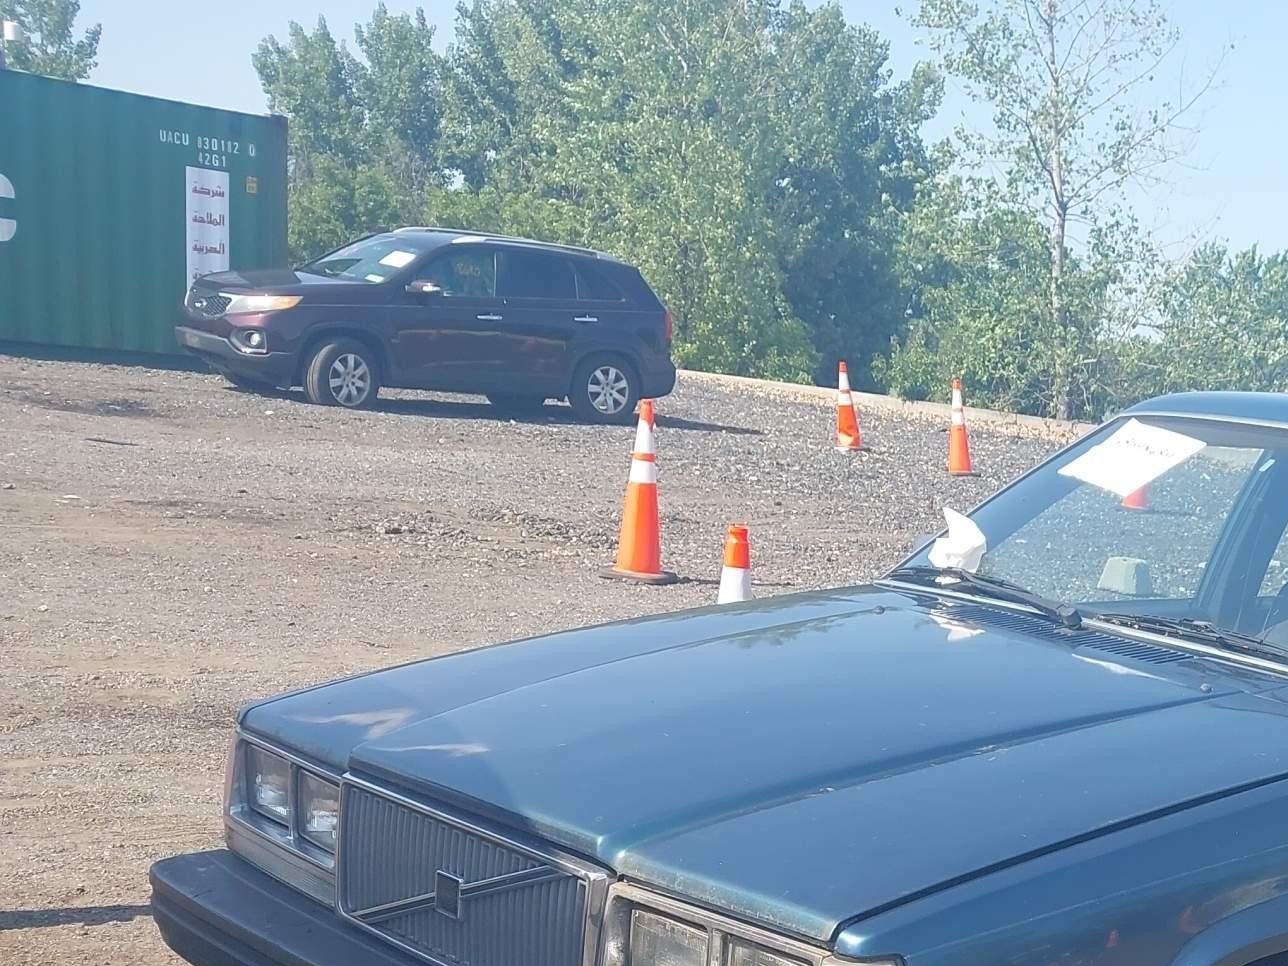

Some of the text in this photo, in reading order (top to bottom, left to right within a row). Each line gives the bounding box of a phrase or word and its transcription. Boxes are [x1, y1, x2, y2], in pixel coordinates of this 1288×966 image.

[159, 129, 189, 145] UACU
[198, 151, 226, 167] 42G1
[191, 180, 225, 198] شركة
